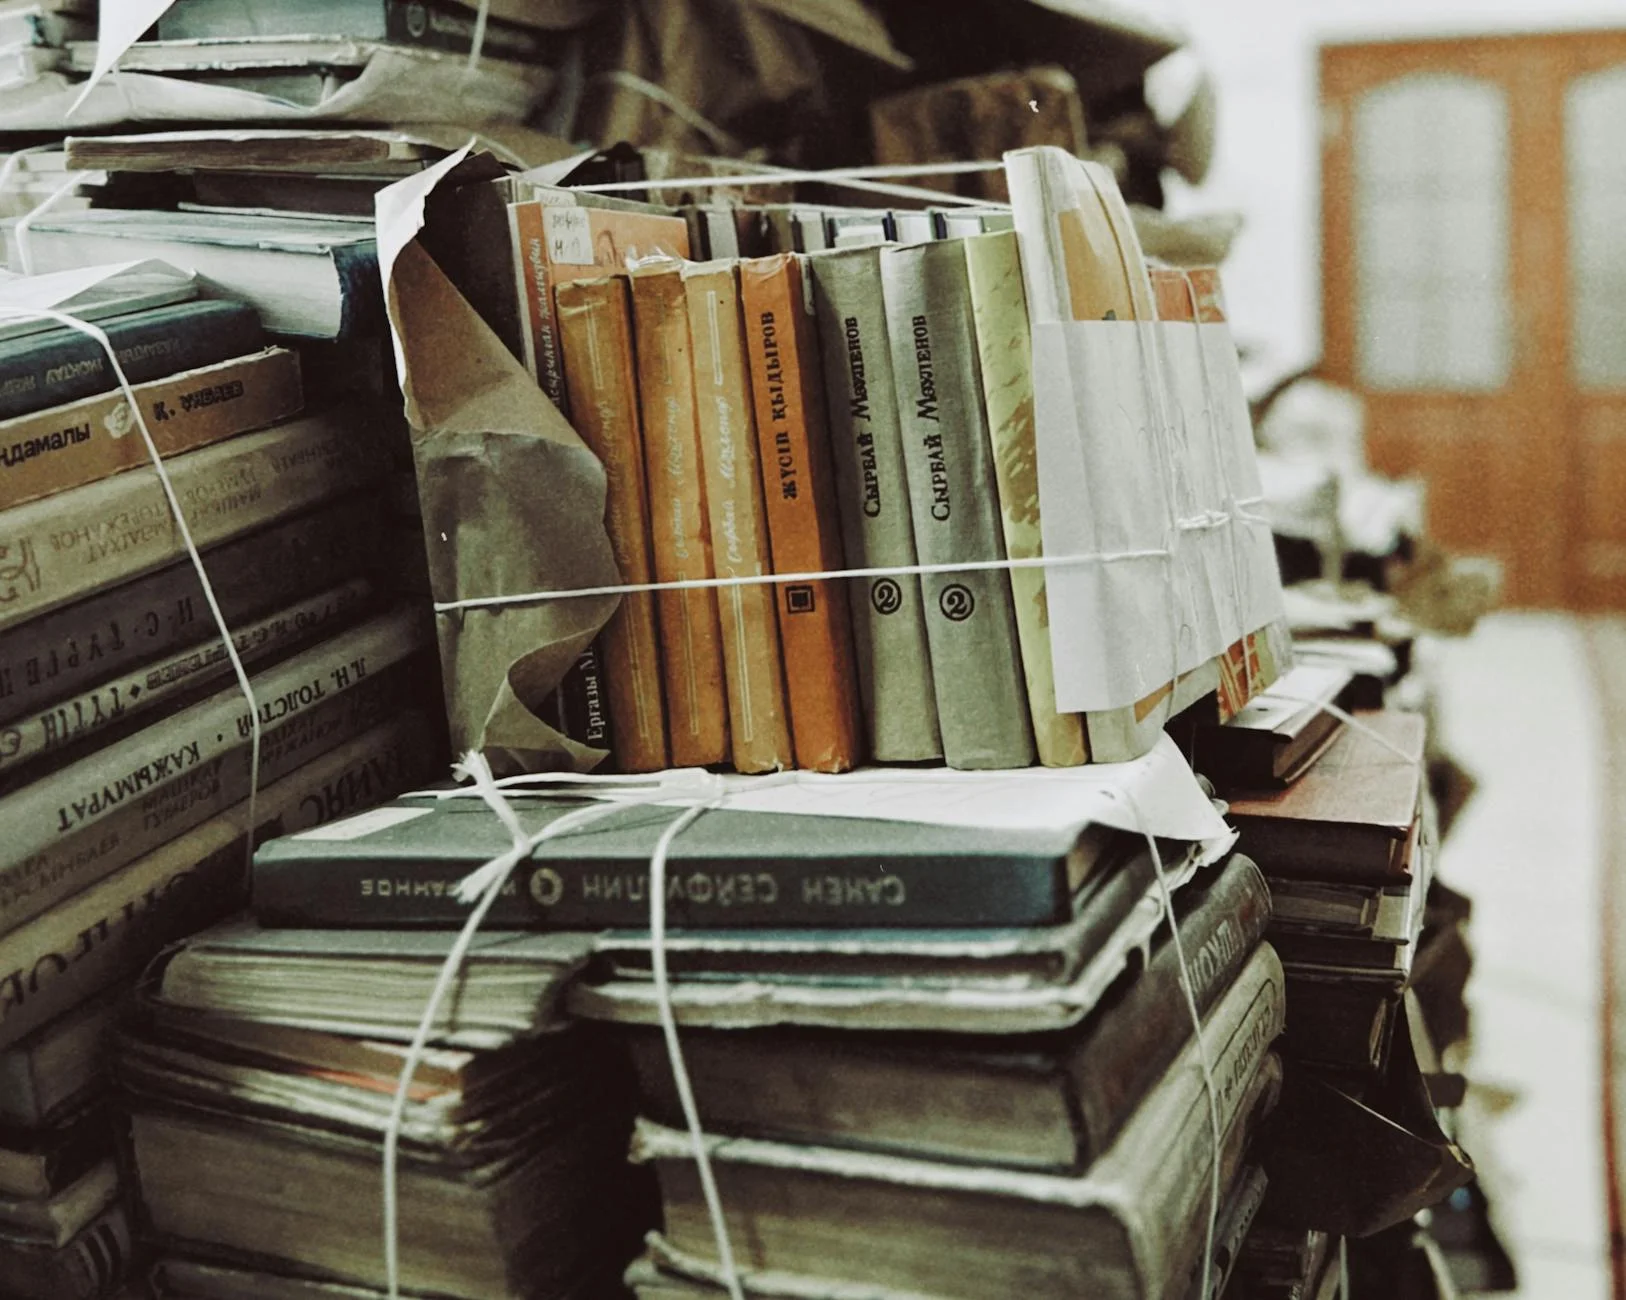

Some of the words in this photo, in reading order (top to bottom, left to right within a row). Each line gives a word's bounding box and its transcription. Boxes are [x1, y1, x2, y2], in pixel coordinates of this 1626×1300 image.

[585, 675, 606, 741] Ергазы
[360, 878, 517, 898] ИАННОЕ
[581, 873, 779, 907] СЕЙФУЛИН
